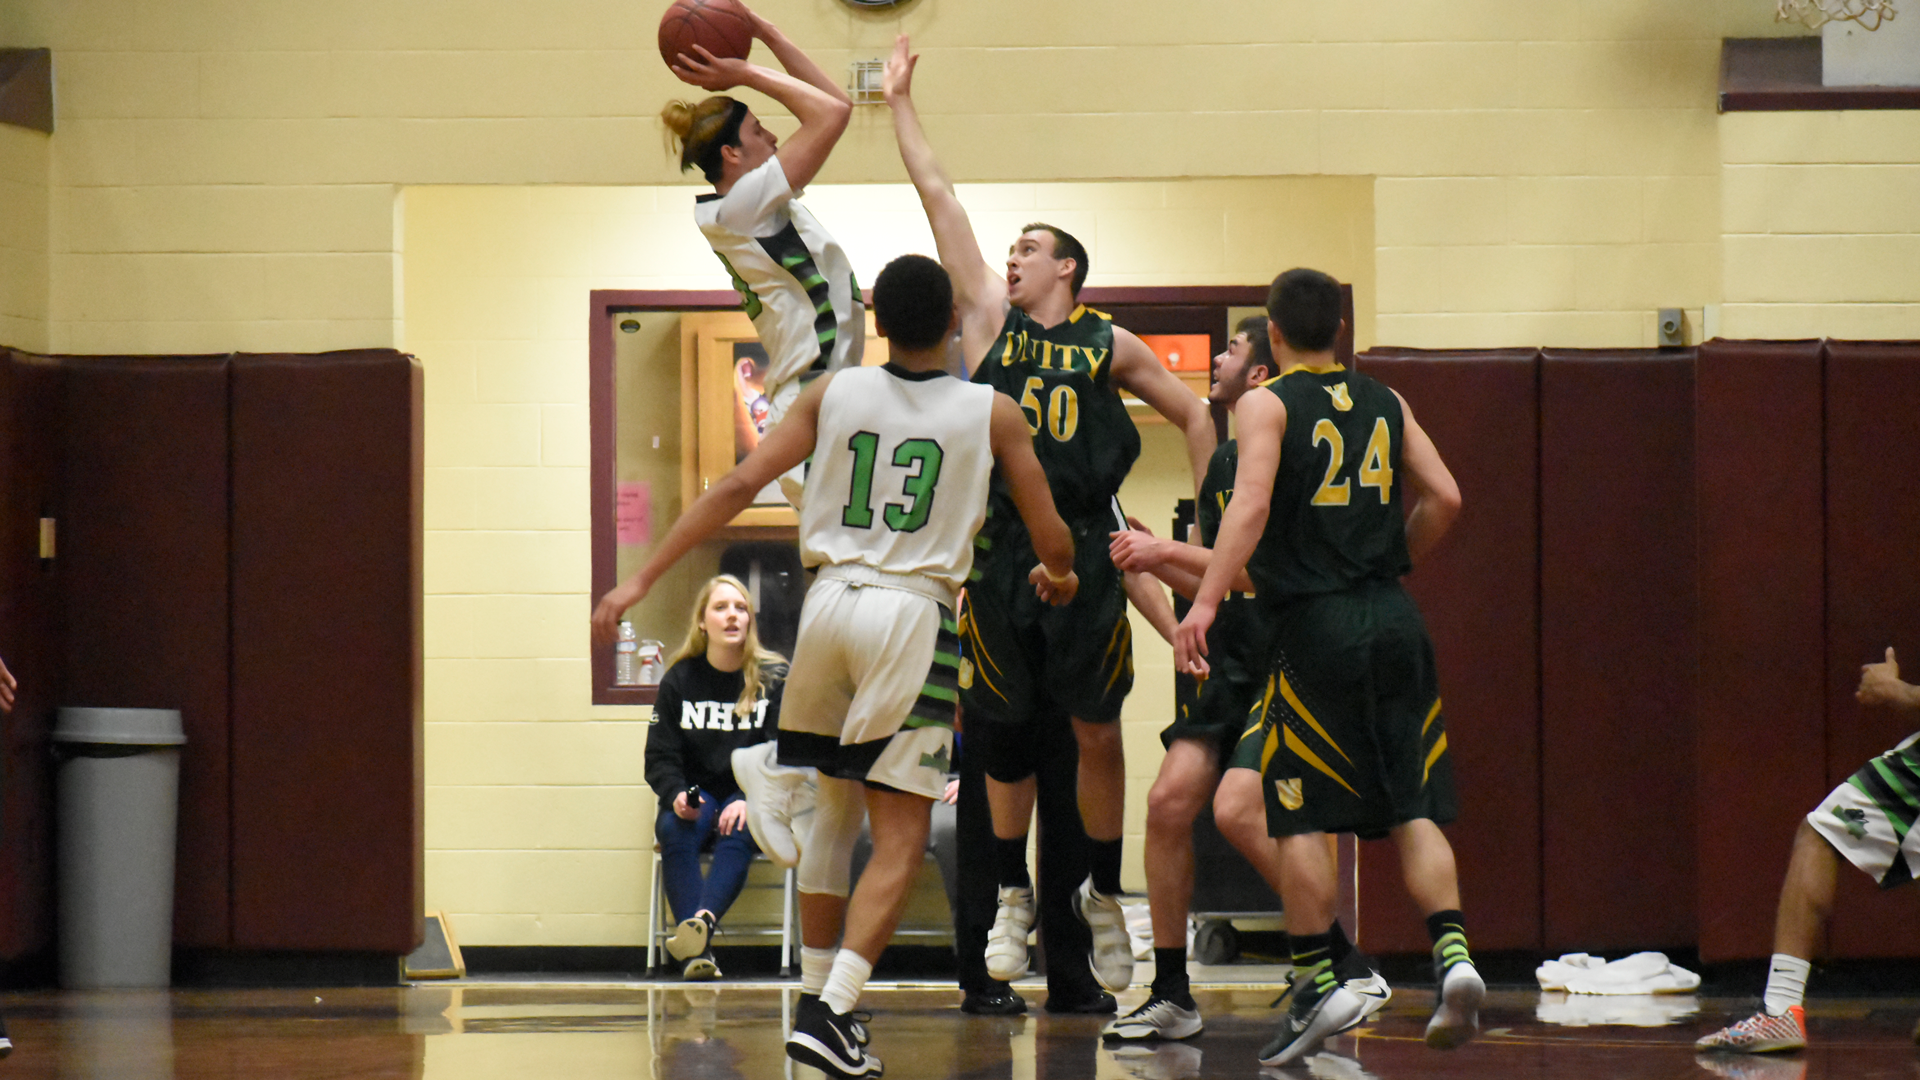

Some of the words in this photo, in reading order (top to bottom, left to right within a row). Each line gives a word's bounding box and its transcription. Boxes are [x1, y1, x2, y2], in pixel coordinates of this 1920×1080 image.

[1002, 330, 1108, 382] UNITY
[1020, 376, 1078, 442] 50
[842, 430, 944, 533] 13
[1311, 417, 1393, 506] 24
